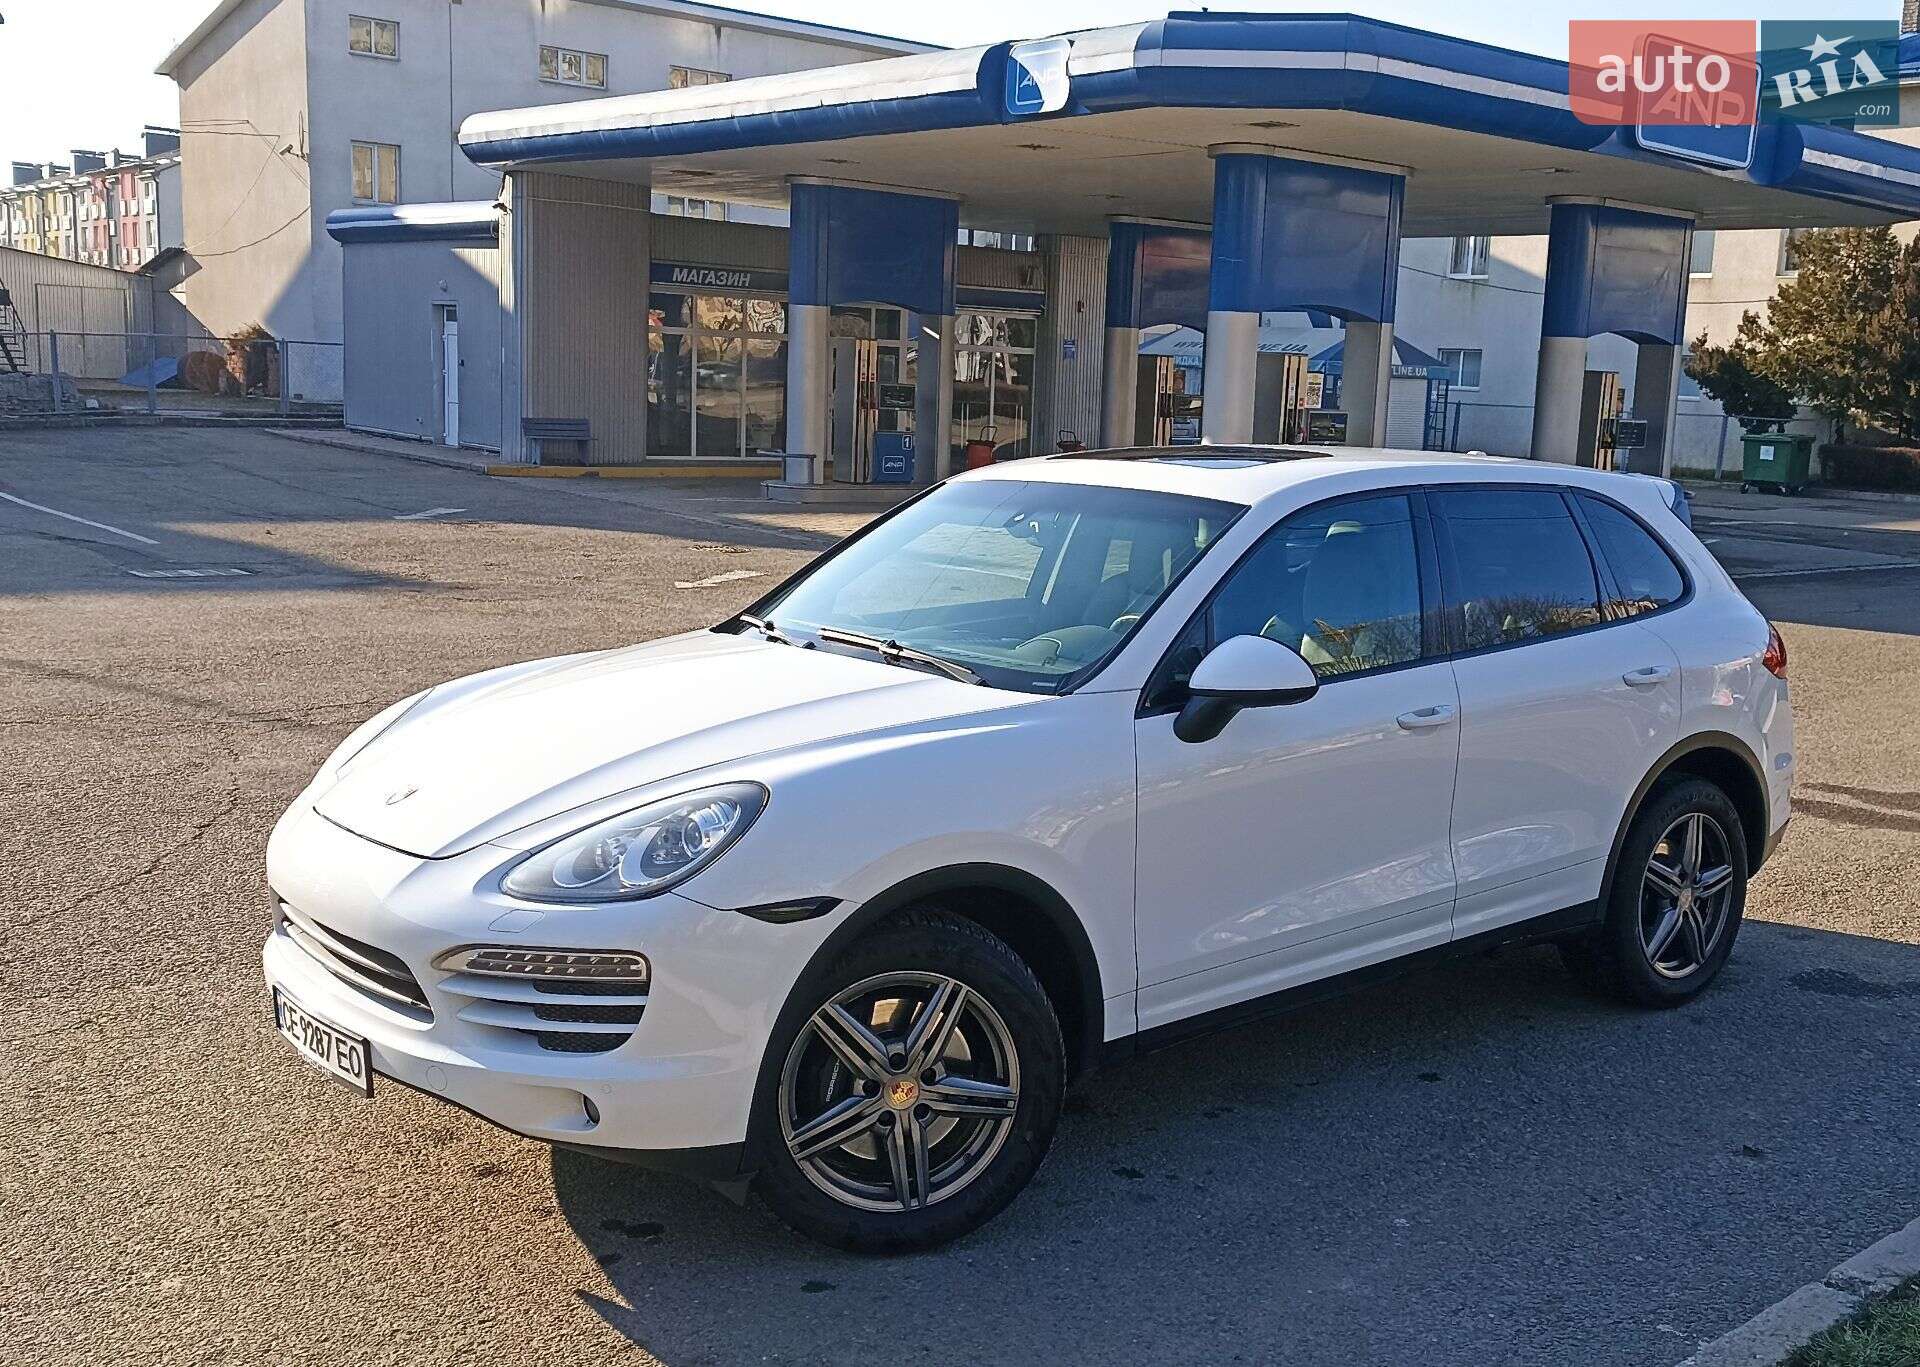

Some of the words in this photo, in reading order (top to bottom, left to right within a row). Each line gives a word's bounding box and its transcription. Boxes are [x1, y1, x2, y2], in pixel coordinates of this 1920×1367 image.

[672, 267, 751, 287] МАГАЗИН
[1391, 366, 1427, 377] LINE.UA
[904, 437, 910, 448] 1
[282, 1001, 301, 1041] CE
[300, 1015, 332, 1062] 9287
[335, 1036, 361, 1078] EO
